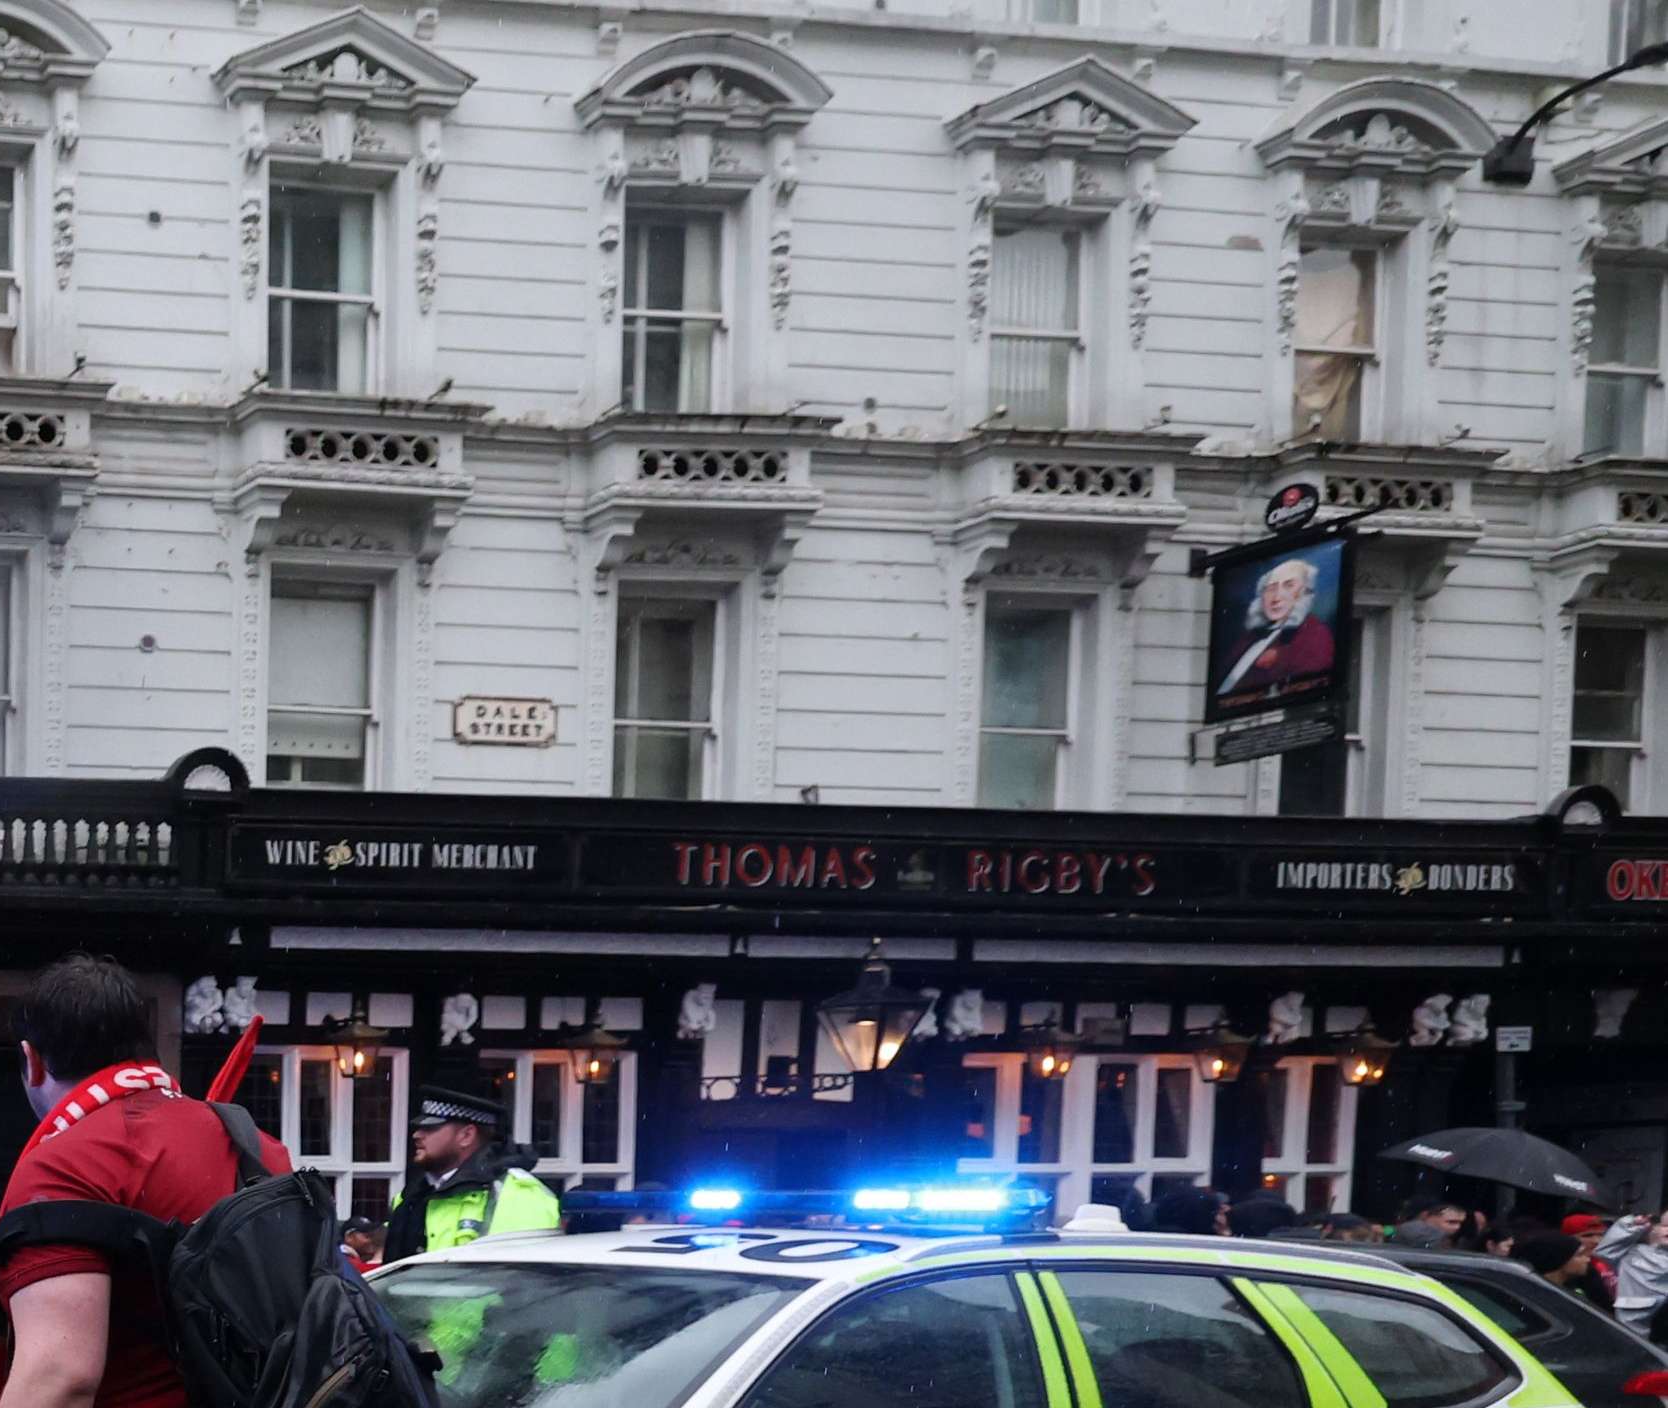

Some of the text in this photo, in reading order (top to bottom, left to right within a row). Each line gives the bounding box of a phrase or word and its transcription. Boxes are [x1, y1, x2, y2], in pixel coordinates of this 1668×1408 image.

[476, 705, 536, 719] DALE
[470, 722, 543, 736] STREET
[265, 840, 320, 866] WINE
[354, 842, 424, 868] SPIRIT
[431, 843, 537, 870] MERCHANT
[673, 842, 1157, 896] THOMAS RIGBY'S
[1276, 861, 1392, 890] IMPORTERS
[1428, 864, 1516, 891] BONDERS
